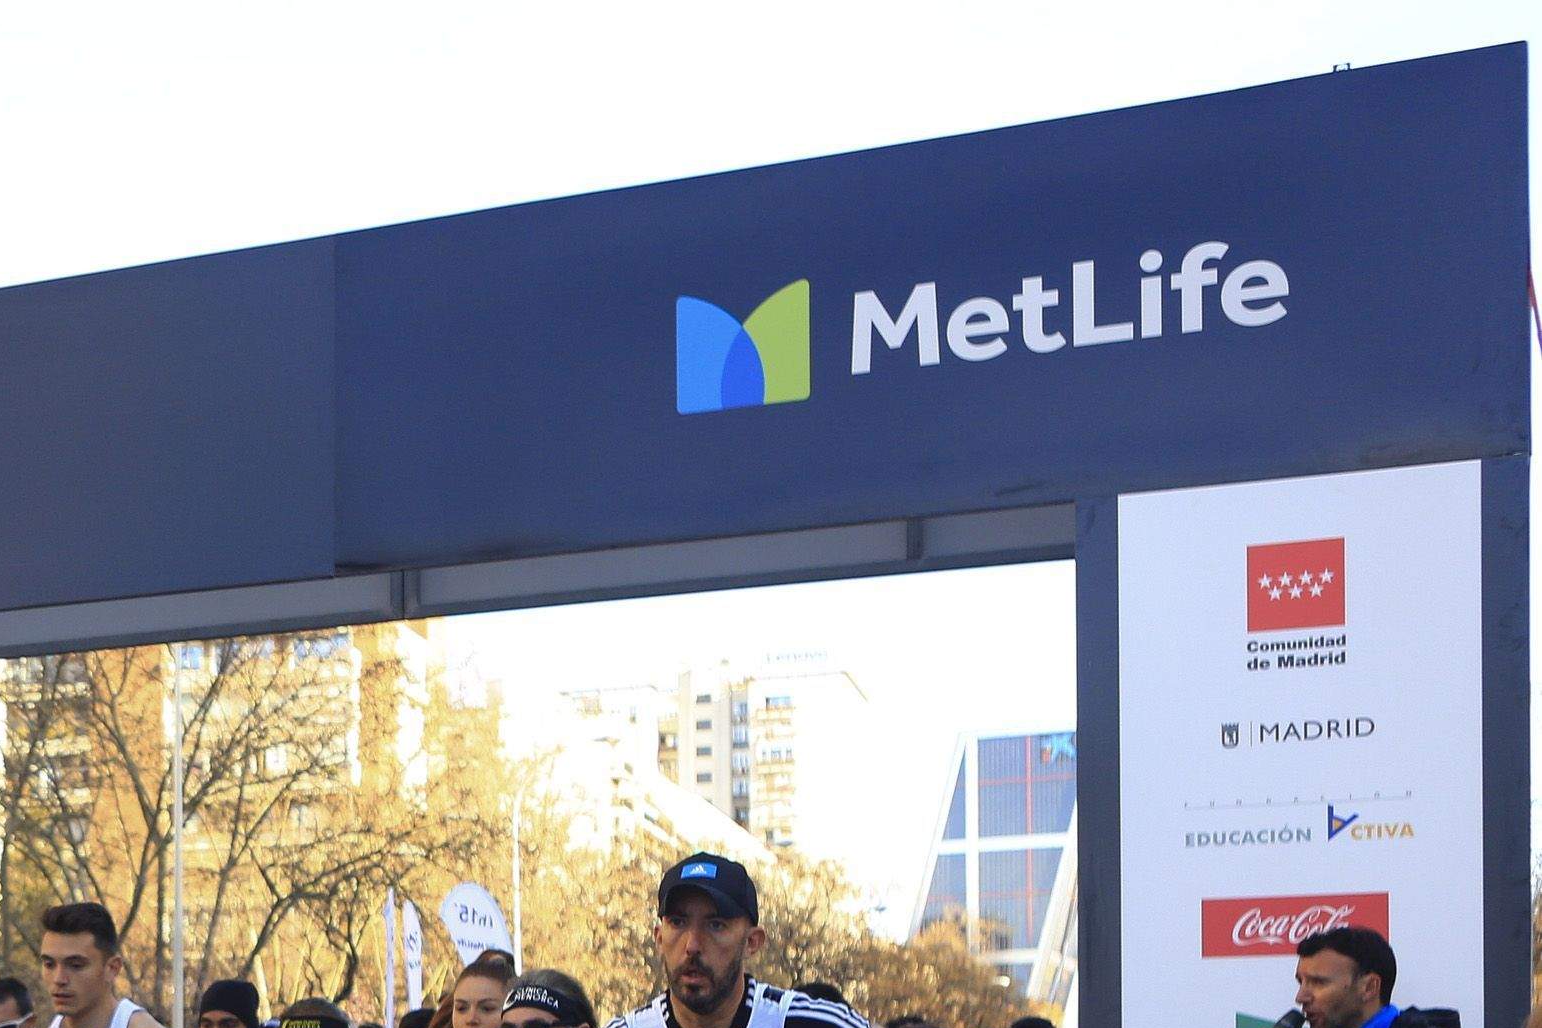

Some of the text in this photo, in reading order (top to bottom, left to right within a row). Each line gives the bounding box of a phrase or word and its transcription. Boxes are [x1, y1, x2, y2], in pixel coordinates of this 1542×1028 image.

[851, 241, 1290, 375] MetLife
[1247, 634, 1347, 652] Comunidad
[1247, 651, 1346, 671] de Madrid
[1260, 717, 1376, 743] MADRID
[1185, 804, 1415, 848] EDUCACIÓN ACTIVA
